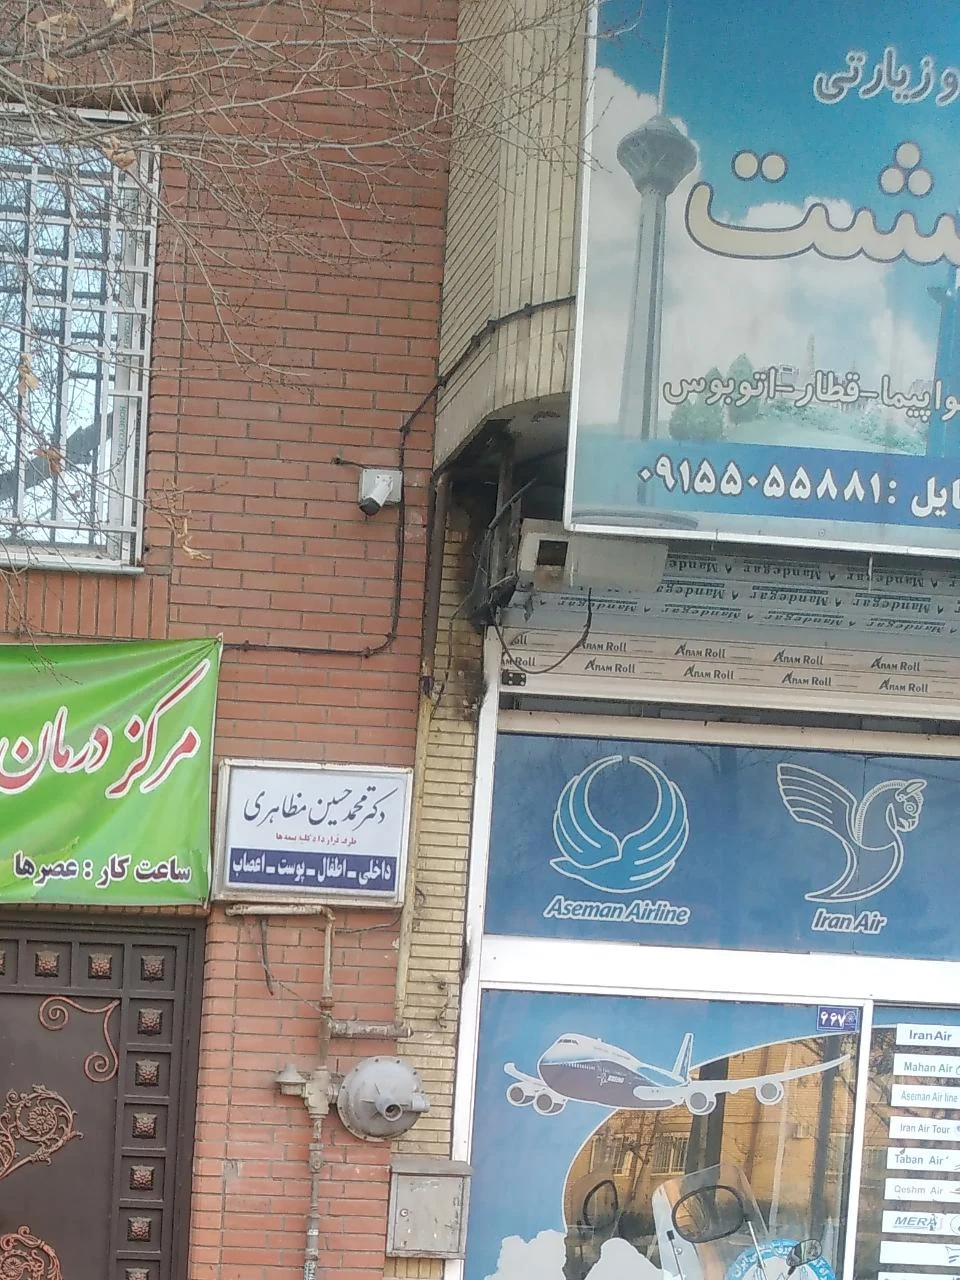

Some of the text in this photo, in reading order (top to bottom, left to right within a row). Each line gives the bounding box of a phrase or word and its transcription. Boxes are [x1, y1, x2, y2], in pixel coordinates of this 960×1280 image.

[813, 46, 935, 104] زیارتی
[685, 140, 960, 267] شت
[667, 559, 720, 573] Mande
[656, 583, 726, 600] Mandega
[606, 641, 627, 652] Roll
[704, 647, 726, 659] Roll
[803, 654, 824, 666] Roll
[900, 661, 921, 672] Roll
[614, 662, 636, 674] Roll
[713, 669, 734, 681] Roll
[811, 676, 832, 687] Roll
[908, 682, 929, 694] Roll
[104, 659, 210, 798] مرکز
[243, 785, 398, 831] دکتر محمد حسین مظاهری
[14, 850, 79, 887] عصرها
[95, 853, 131, 889] کار
[134, 855, 191, 884] ساعت
[232, 851, 266, 877] اعصاب
[277, 858, 305, 882] پوست
[317, 856, 347, 882] اطفال
[358, 858, 392, 886] داخلی
[543, 896, 691, 926] Aseman Airline
[812, 908, 888, 935] Iran Air
[909, 1029, 952, 1042] Iran Air
[903, 1061, 953, 1074] Mahan Air
[901, 1090, 931, 1102] Aseman
[900, 1123, 951, 1135] Iran Air Tour
[894, 1152, 944, 1166] Taban Air
[929, 1186, 944, 1196] Air
